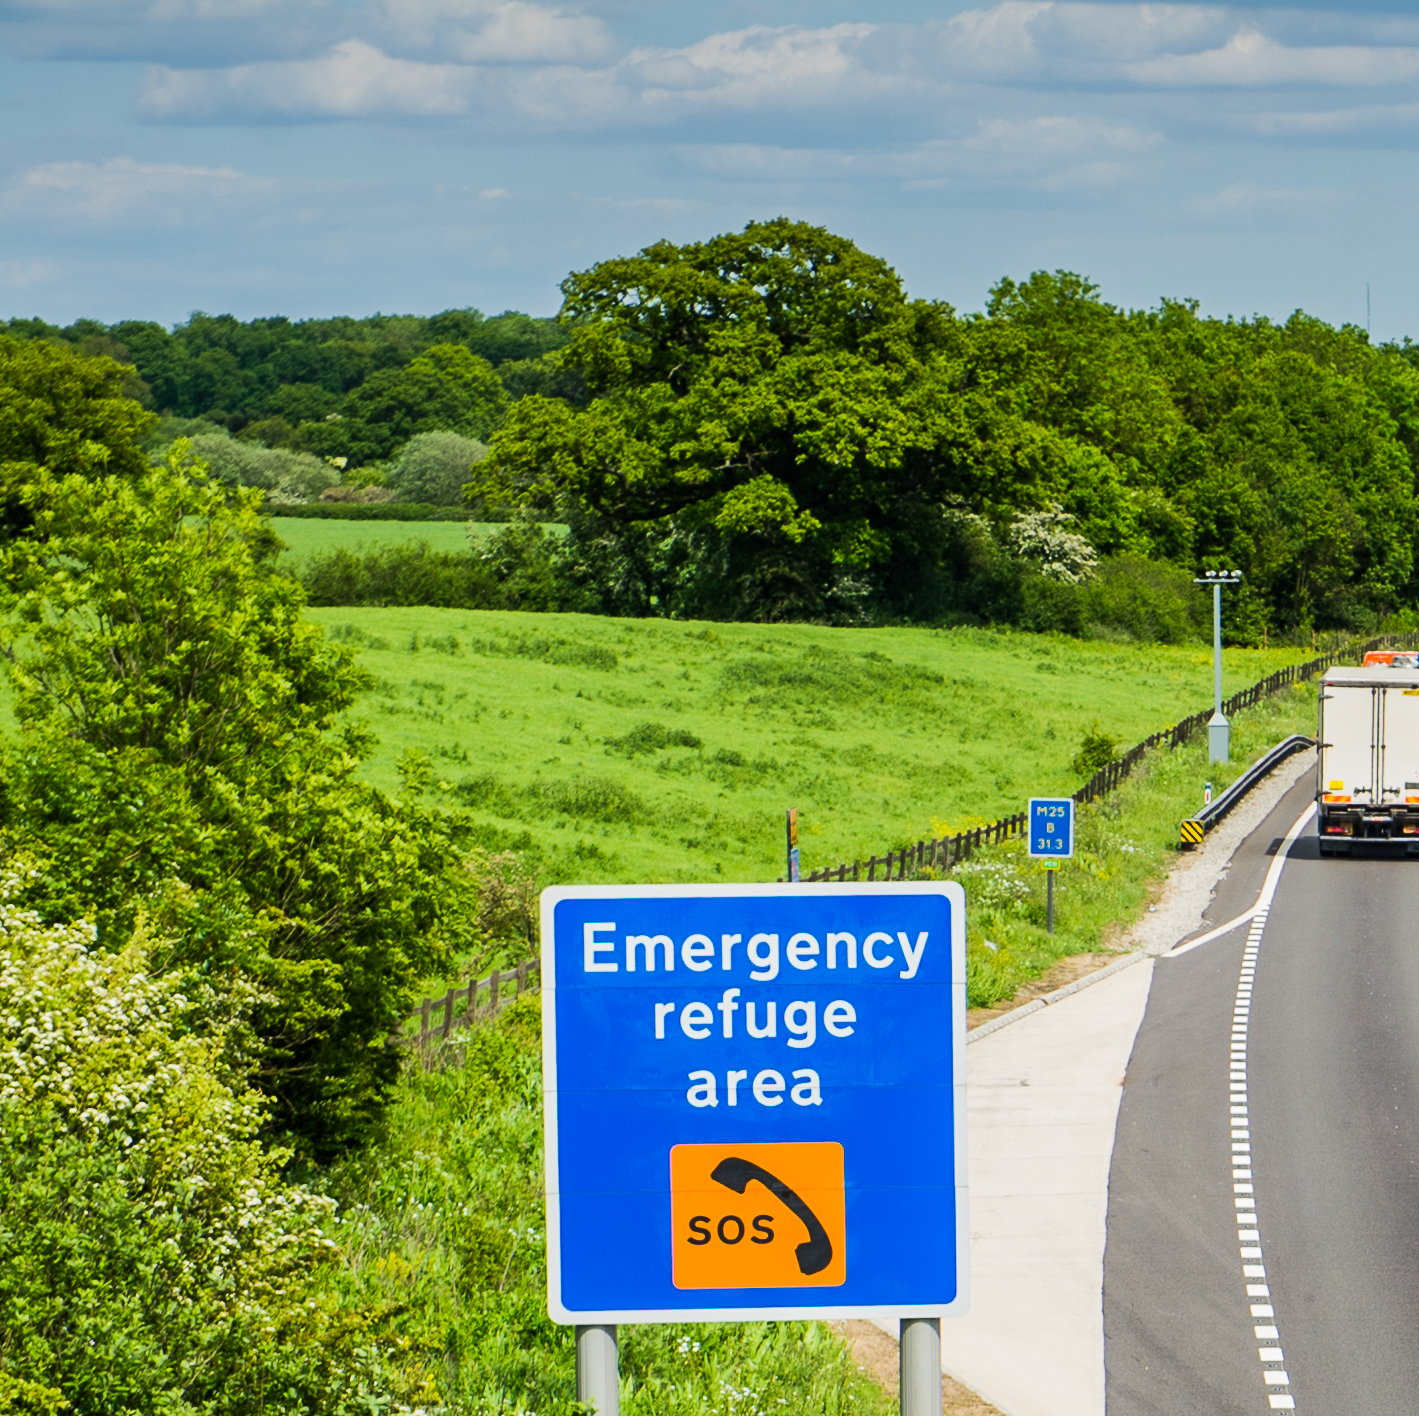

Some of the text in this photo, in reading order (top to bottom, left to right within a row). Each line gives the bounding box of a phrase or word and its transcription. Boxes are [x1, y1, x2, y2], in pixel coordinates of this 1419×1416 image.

[1037, 806, 1065, 817] M25
[1038, 838, 1063, 849] 31.3
[582, 921, 930, 982] Emergency
[654, 987, 857, 1049] refuge
[686, 1068, 824, 1108] area
[686, 1214, 776, 1246] SOS
